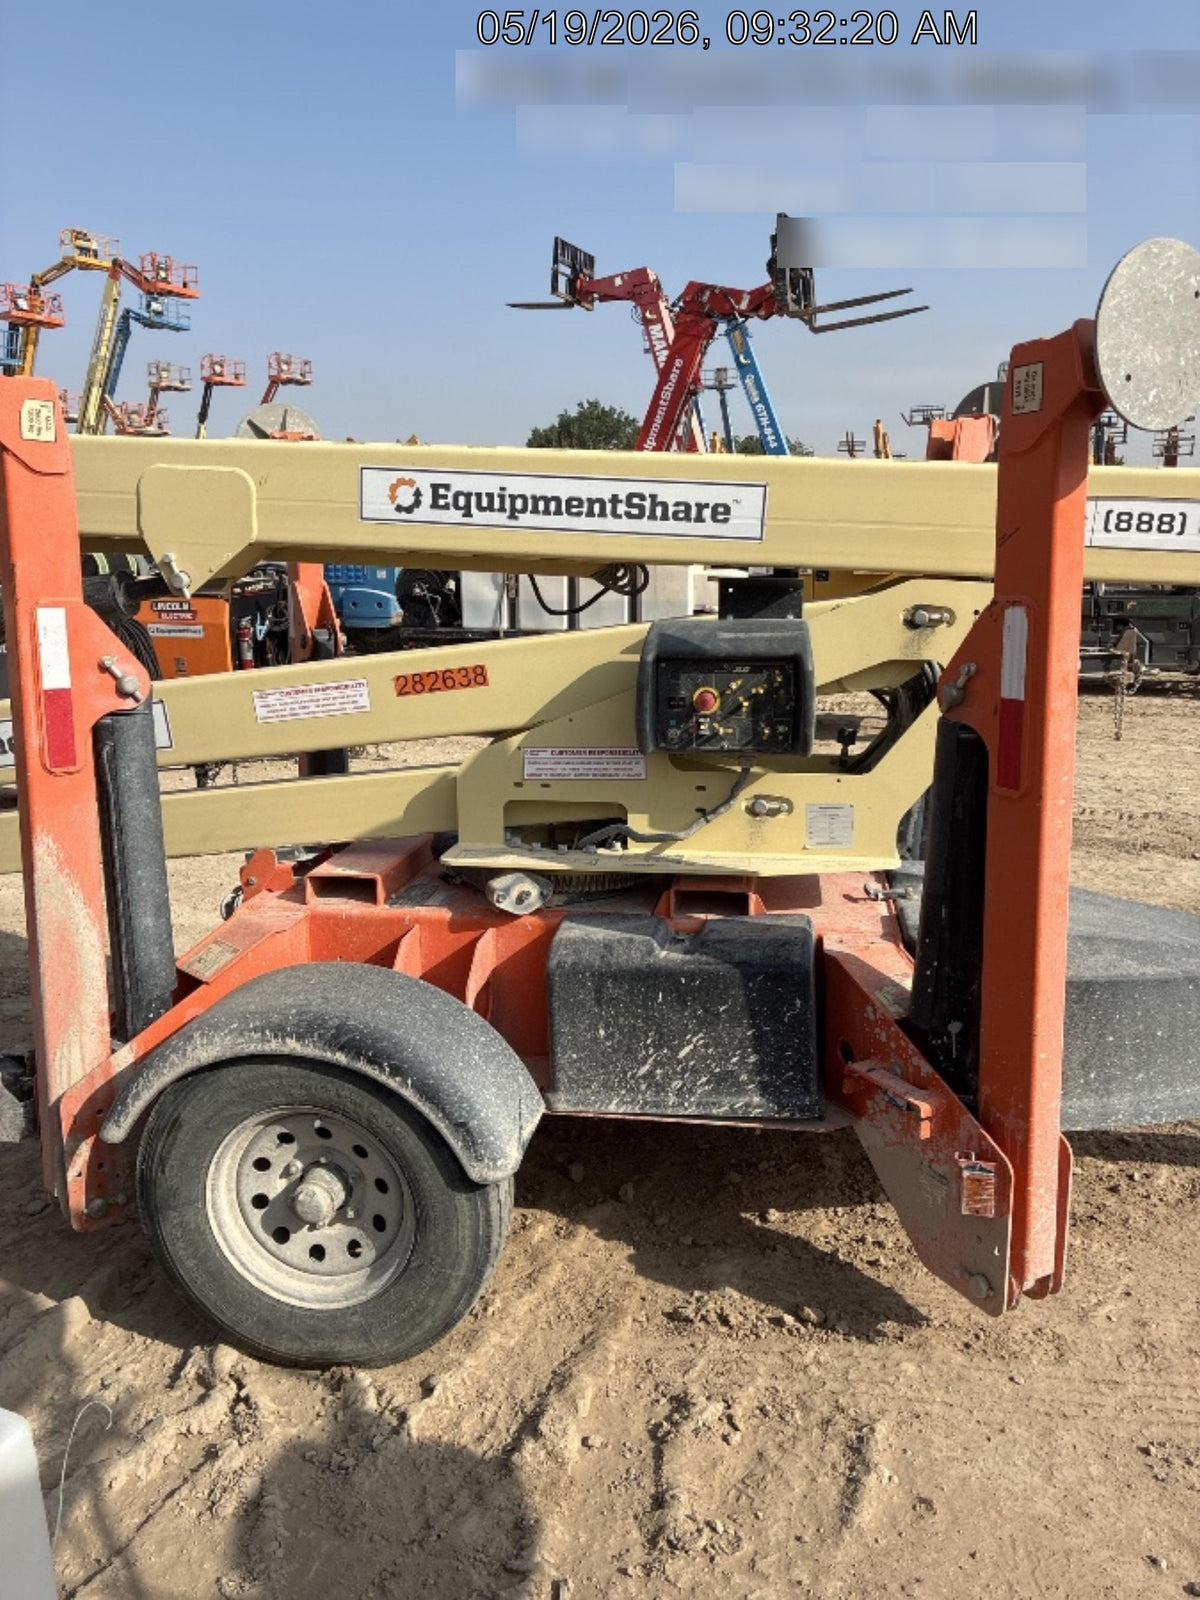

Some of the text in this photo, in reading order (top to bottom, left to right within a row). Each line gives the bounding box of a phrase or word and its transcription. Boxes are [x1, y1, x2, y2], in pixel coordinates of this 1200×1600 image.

[644, 358, 684, 452] ipmentShare
[429, 483, 732, 524] EquipmentShare
[1104, 509, 1187, 536] (888)
[153, 602, 189, 610] LINCOLN
[396, 665, 486, 695] 282638
